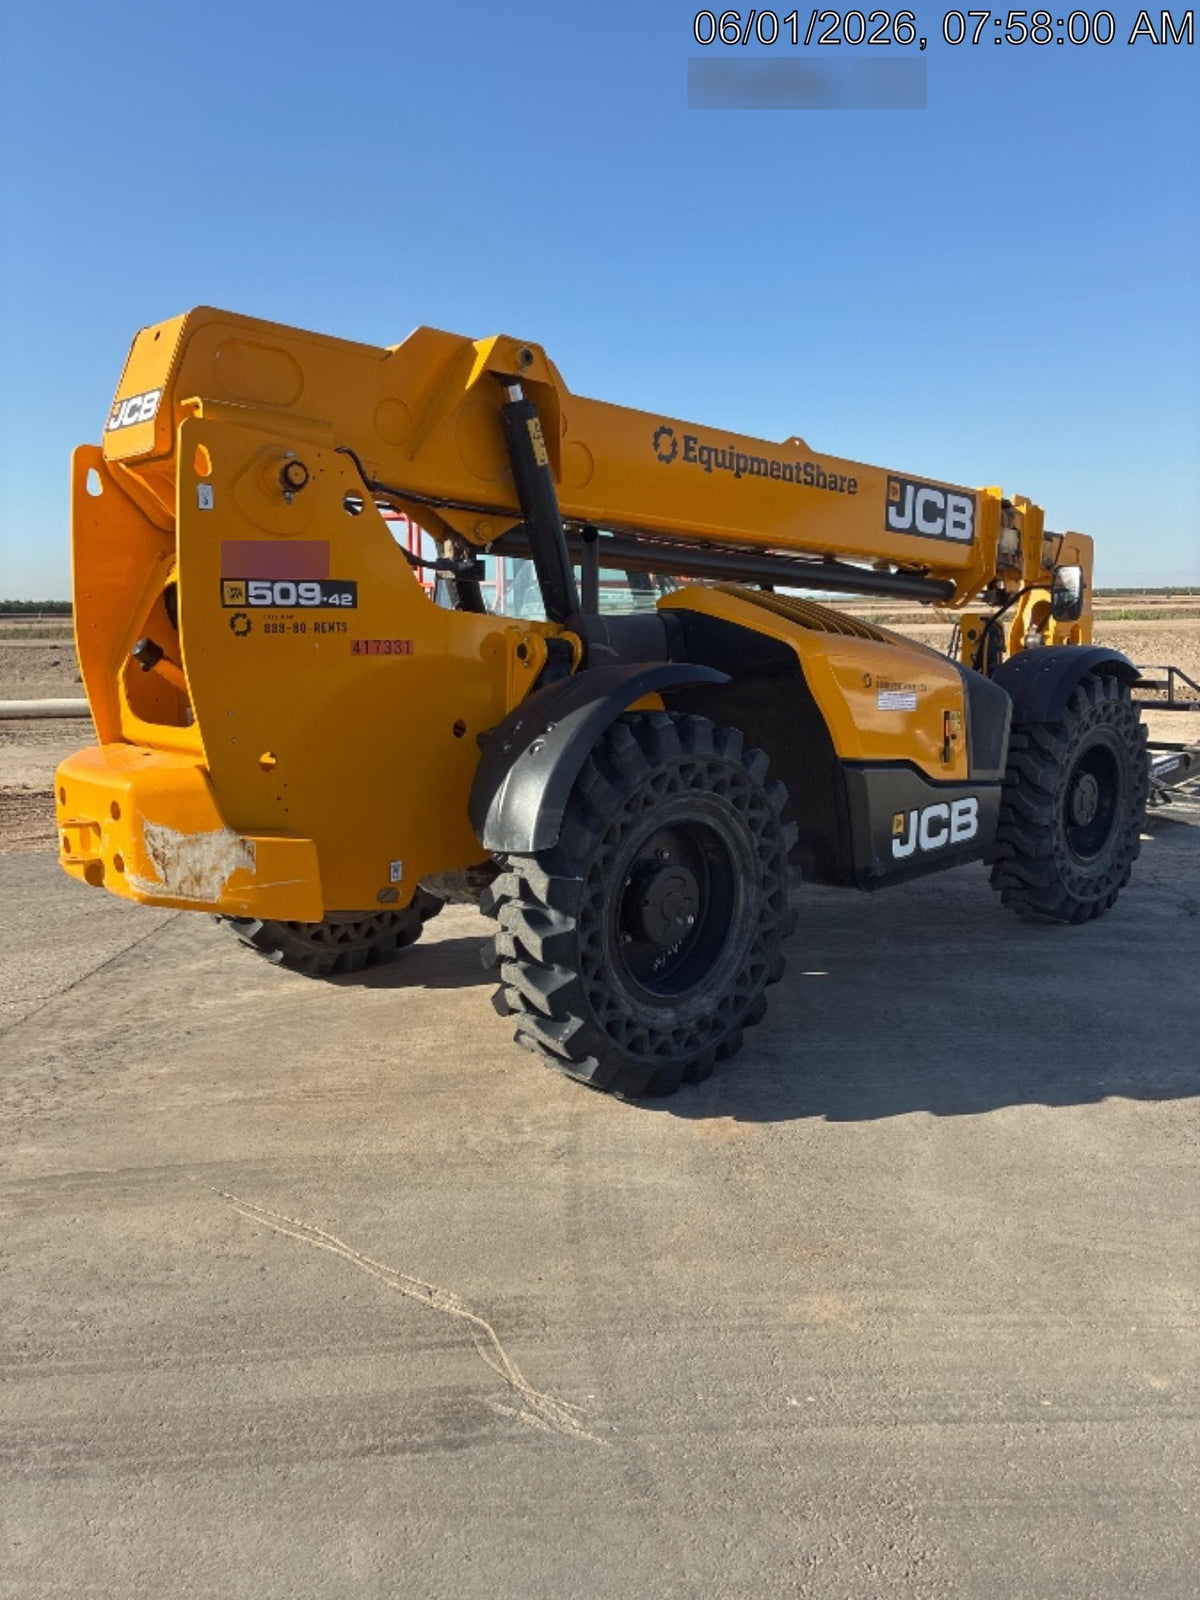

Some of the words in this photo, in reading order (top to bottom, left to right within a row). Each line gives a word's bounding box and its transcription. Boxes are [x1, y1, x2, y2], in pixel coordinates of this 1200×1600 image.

[109, 391, 159, 430] JCB
[683, 435, 858, 494] EquipmentShare
[889, 484, 974, 540] JCB
[352, 640, 411, 654] 417331
[891, 797, 978, 858] JCB
